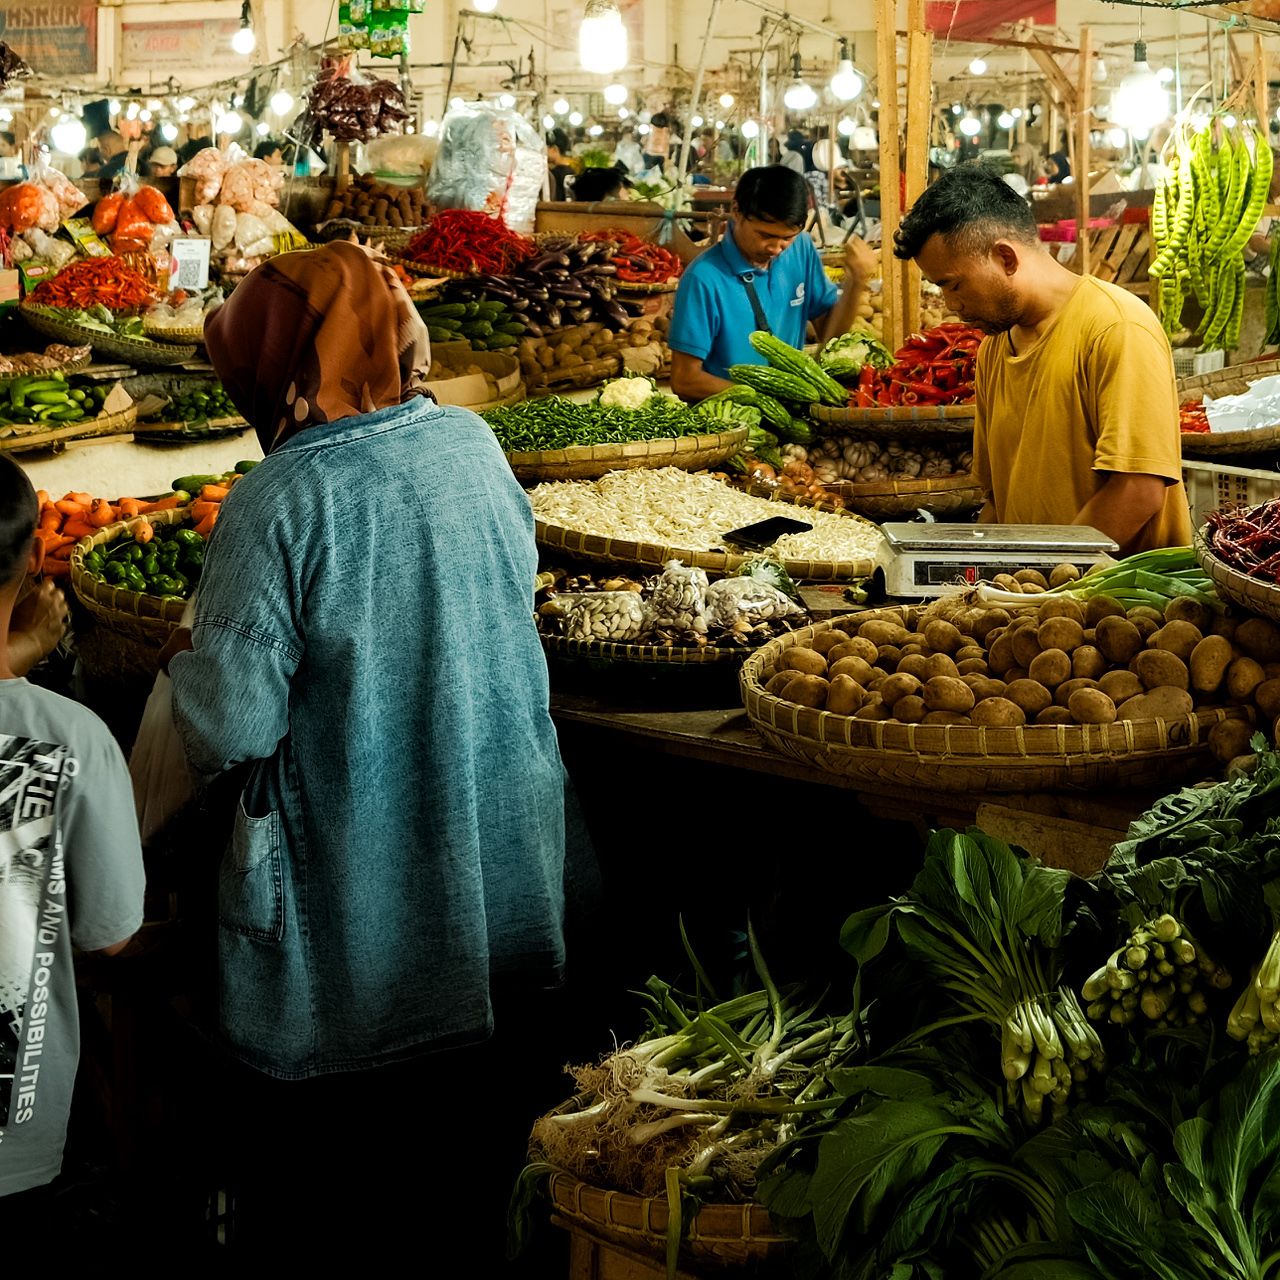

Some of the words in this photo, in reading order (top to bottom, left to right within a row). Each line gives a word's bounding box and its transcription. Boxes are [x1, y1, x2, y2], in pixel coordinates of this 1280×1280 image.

[21, 753, 63, 818] THE
[38, 898, 65, 945] AND
[15, 951, 56, 1125] POSSIBILITIES
